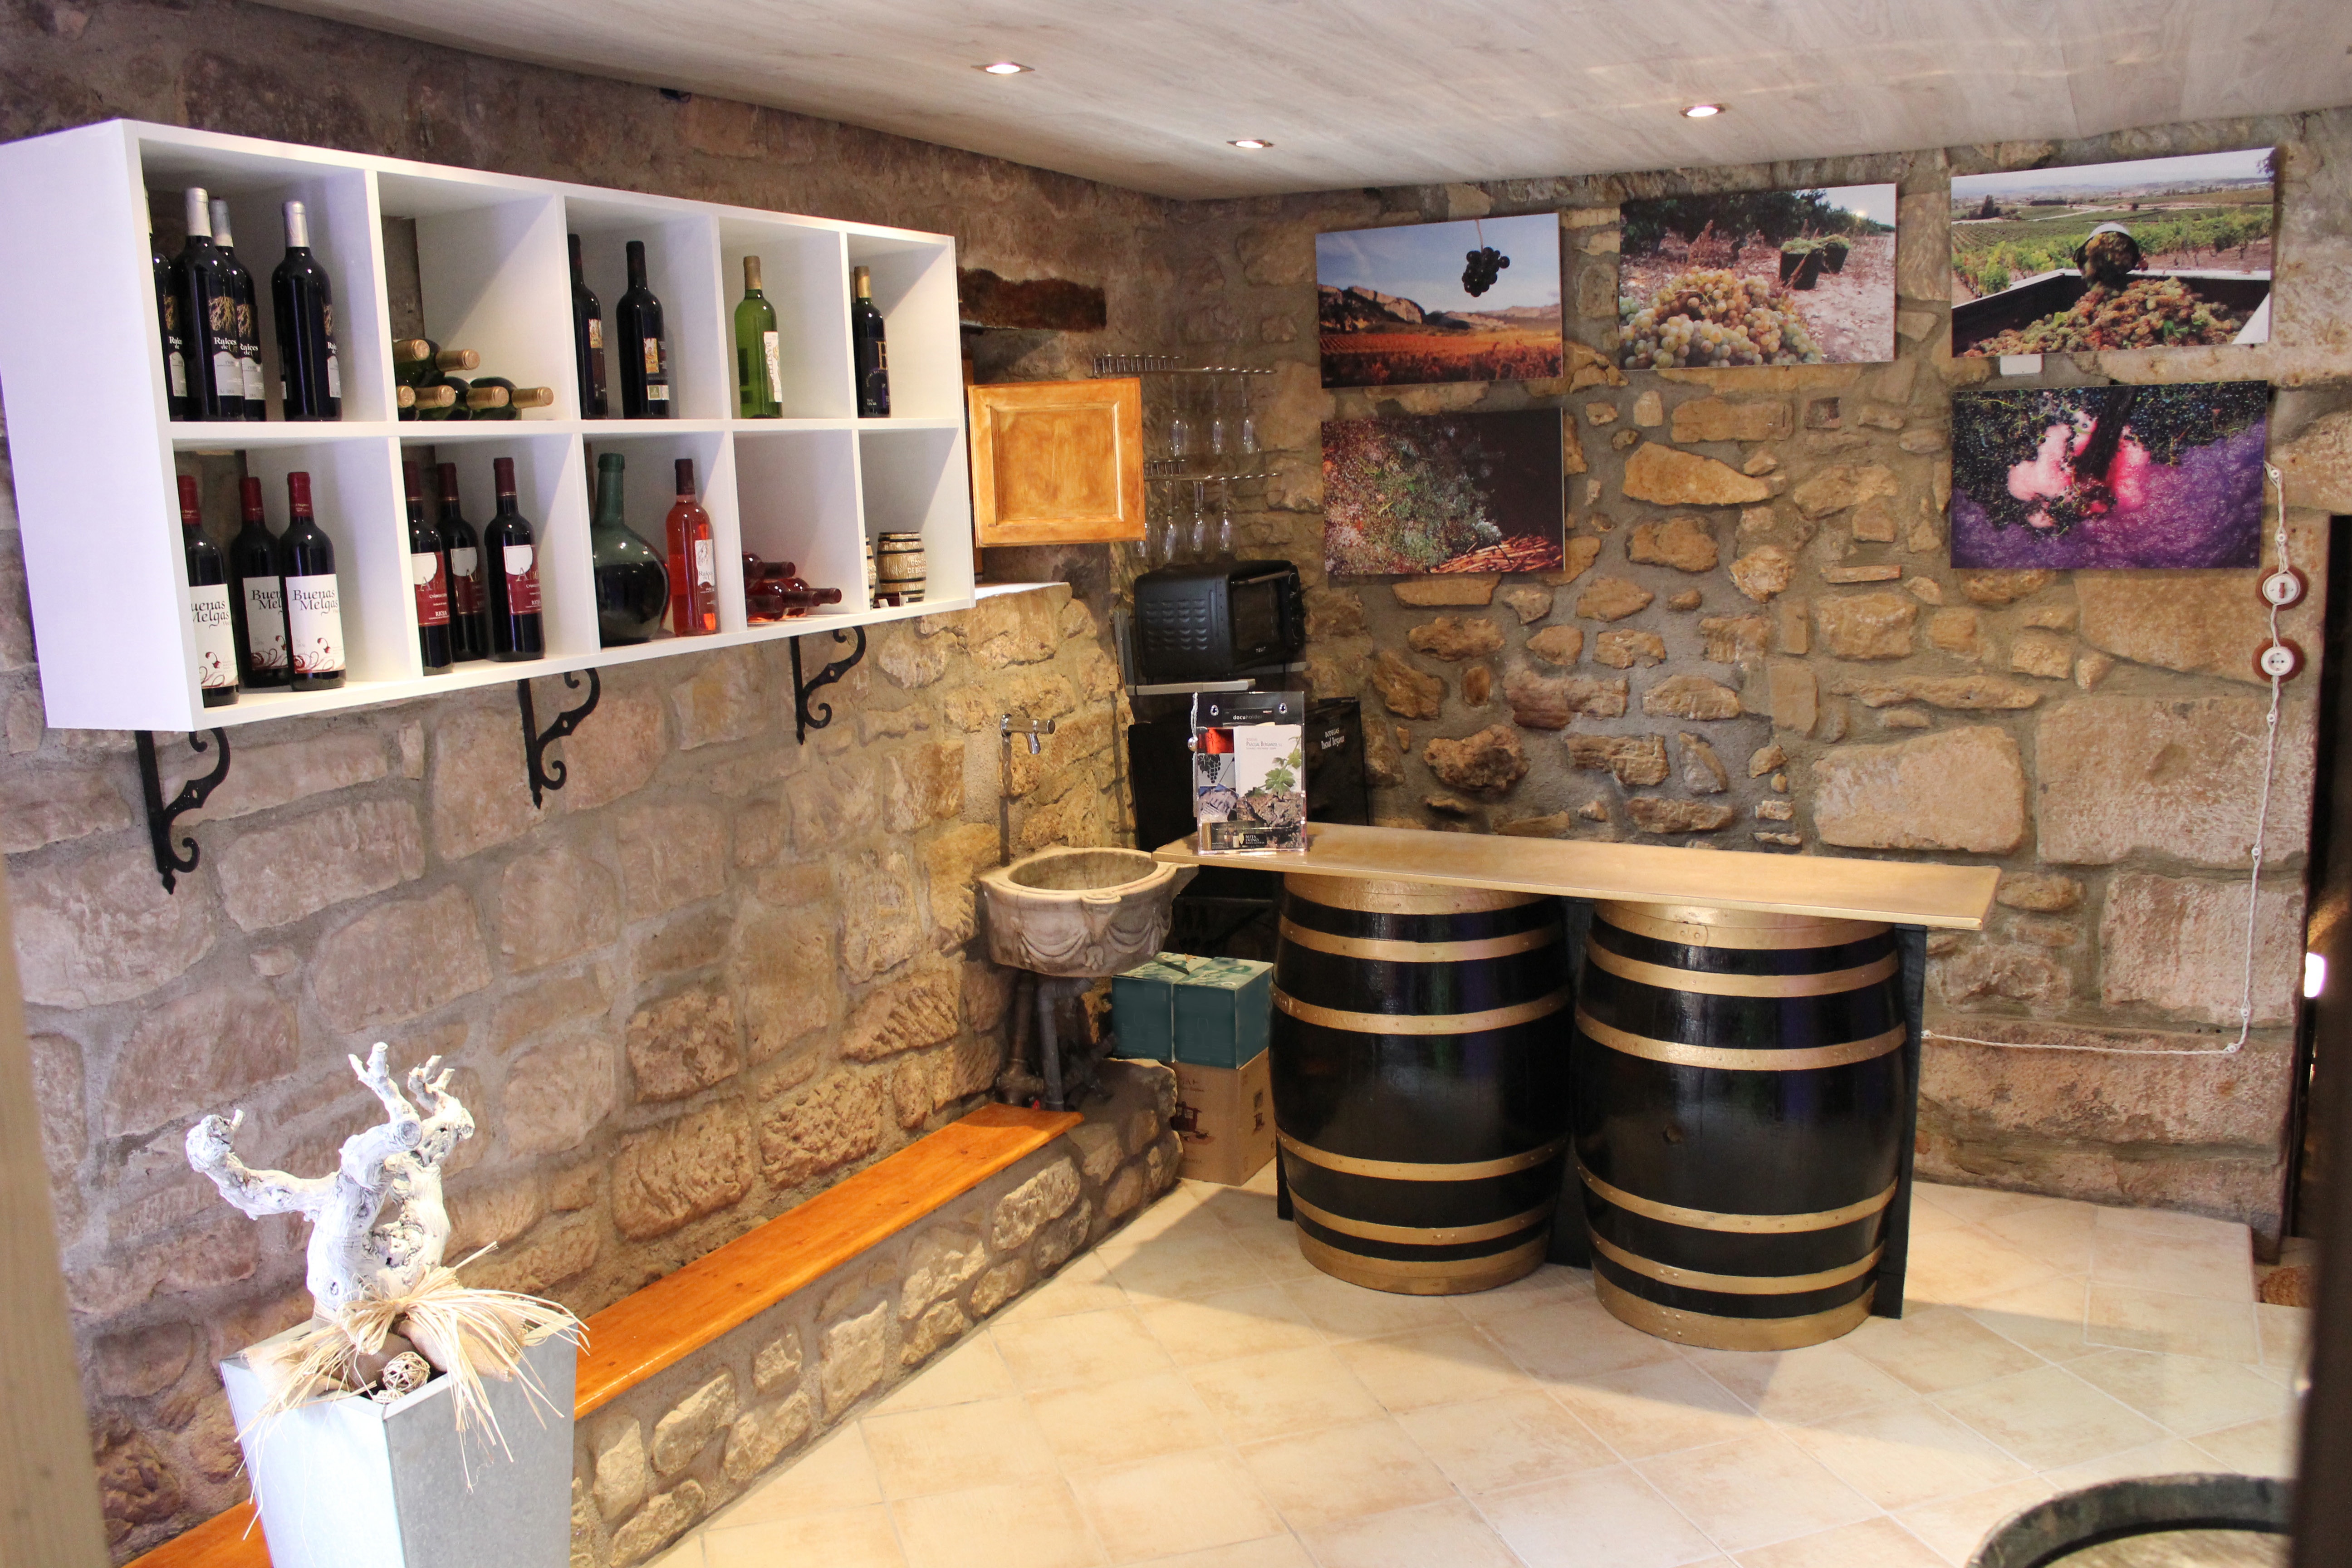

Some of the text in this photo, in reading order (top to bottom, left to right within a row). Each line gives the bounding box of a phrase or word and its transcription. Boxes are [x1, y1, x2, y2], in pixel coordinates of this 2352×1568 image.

[293, 590, 335, 601] Buenas
[191, 600, 226, 612] uenas
[300, 598, 338, 617] Melgas
